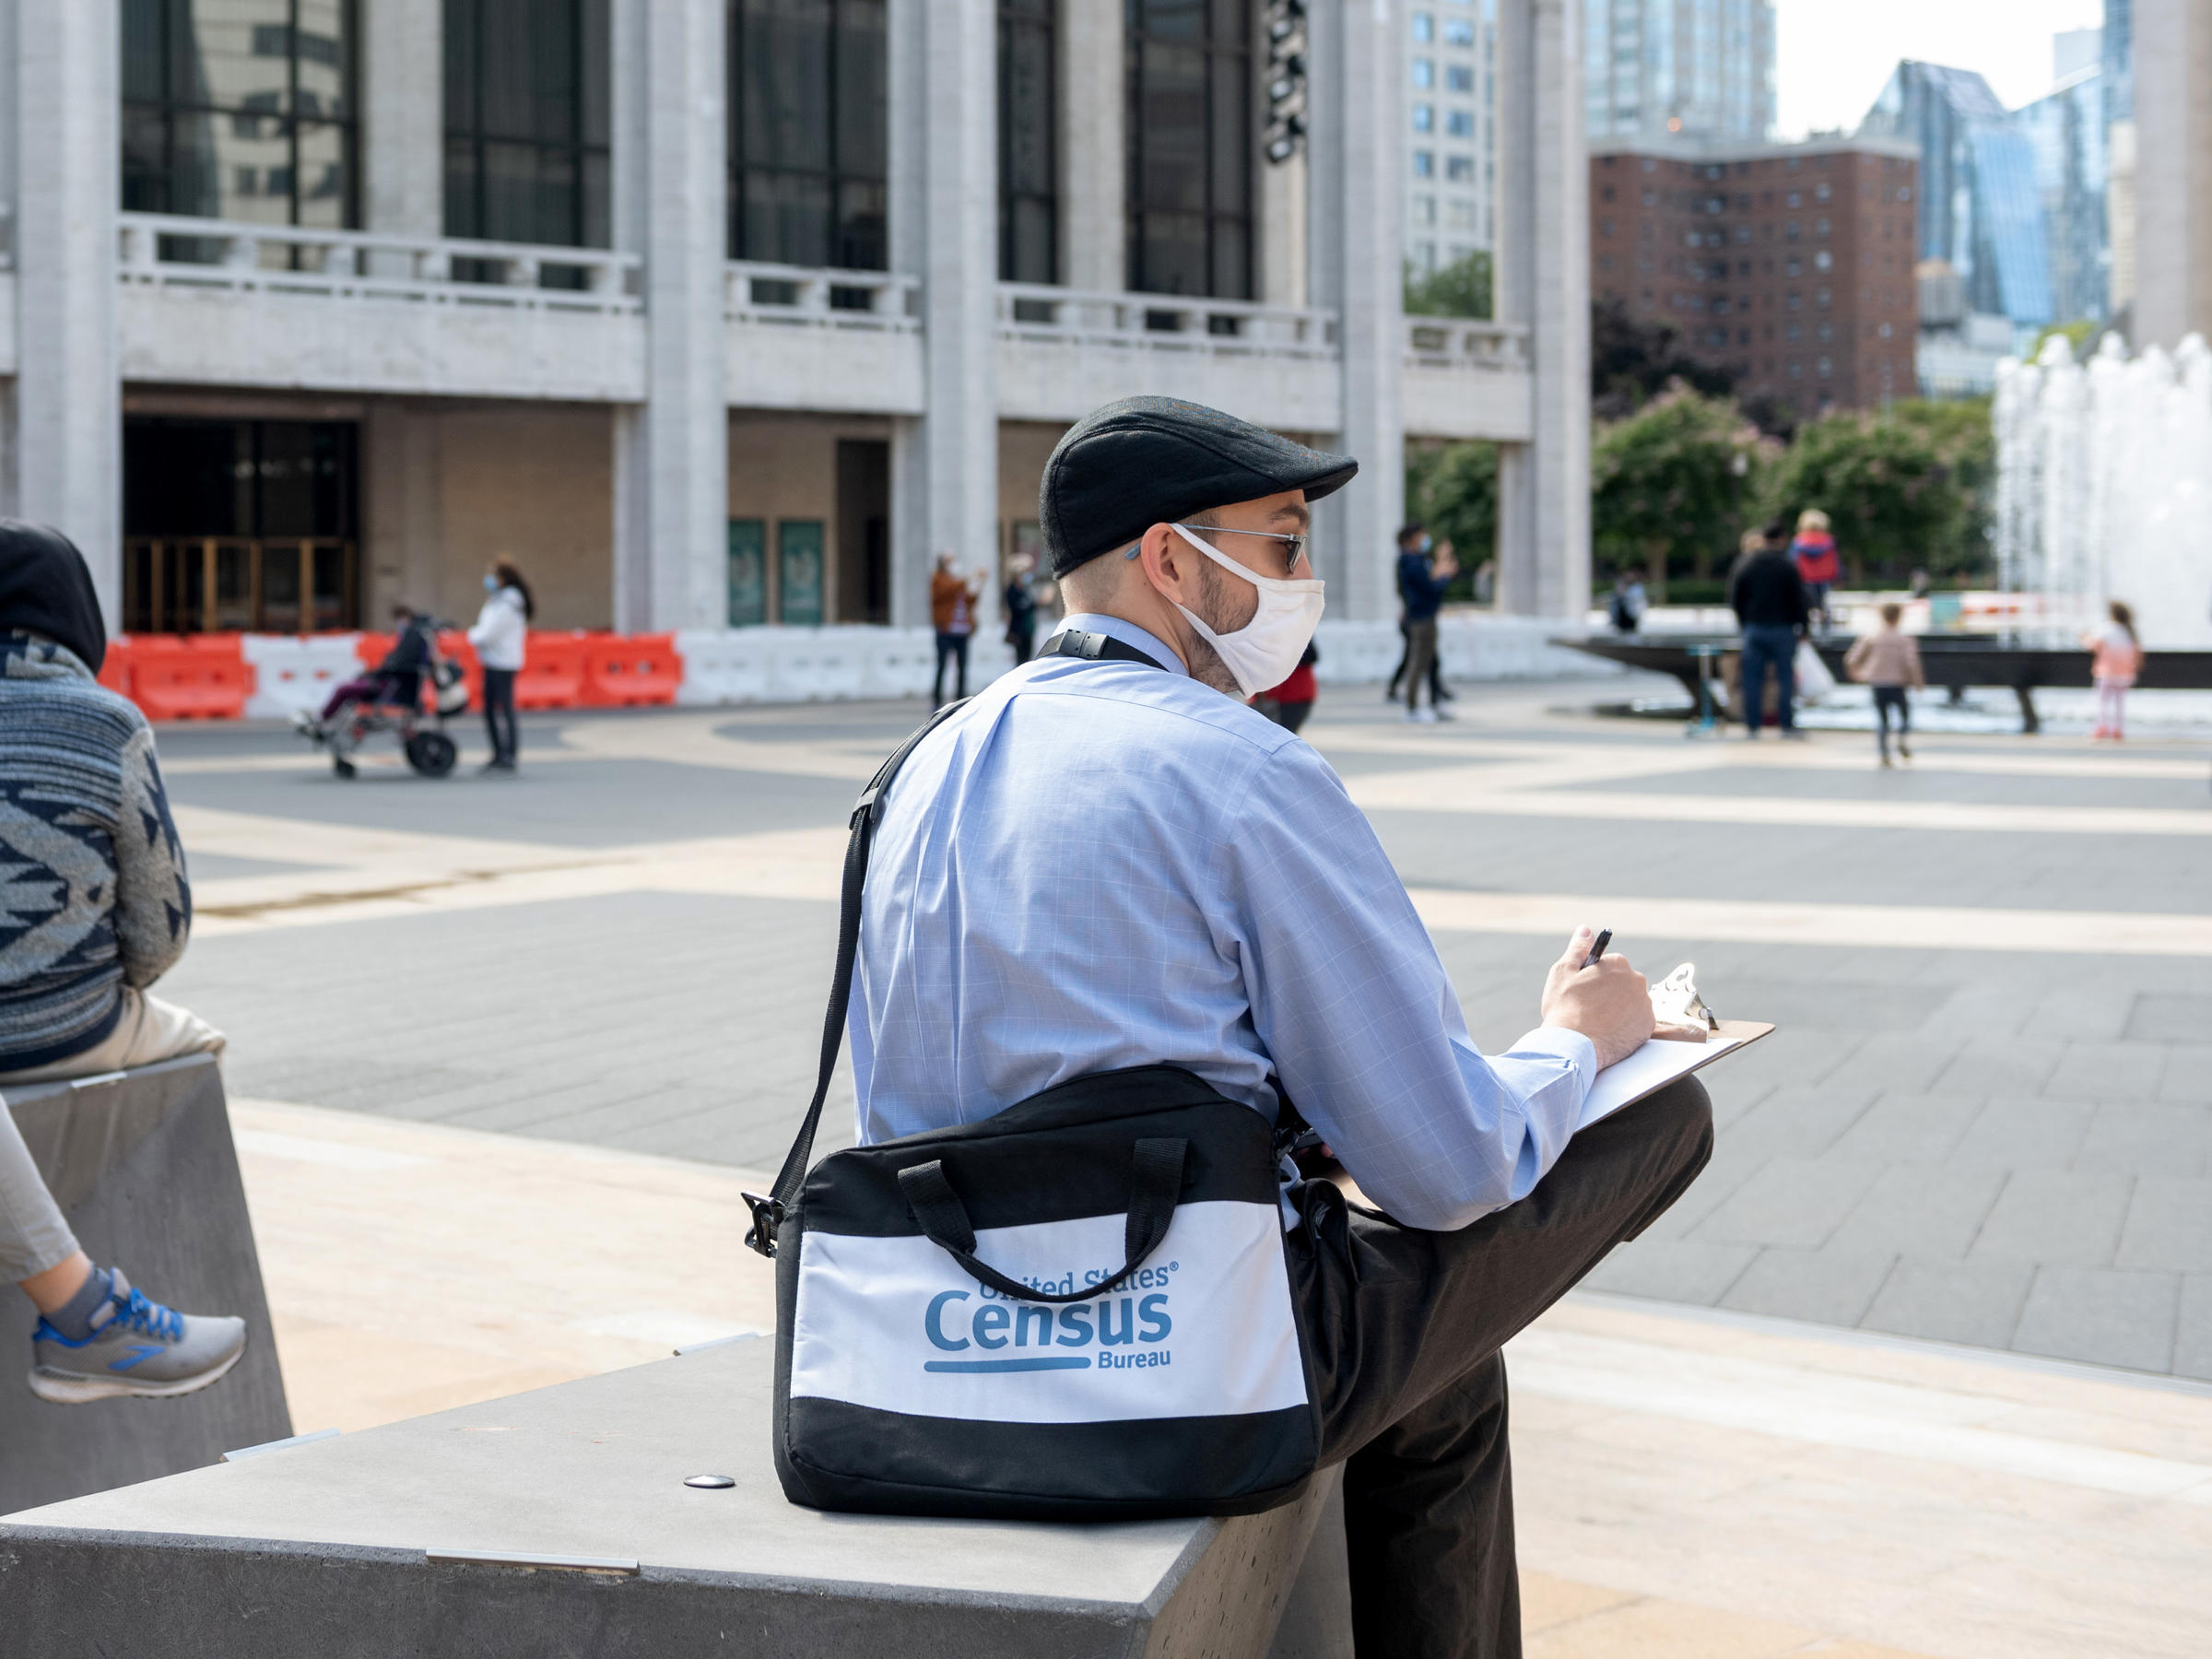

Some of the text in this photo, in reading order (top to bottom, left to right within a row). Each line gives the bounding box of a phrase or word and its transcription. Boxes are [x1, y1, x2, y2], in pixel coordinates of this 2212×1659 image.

[980, 1271, 1074, 1300] Uted
[924, 1290, 1172, 1351] Census
[1098, 1350, 1171, 1370] Bureau
